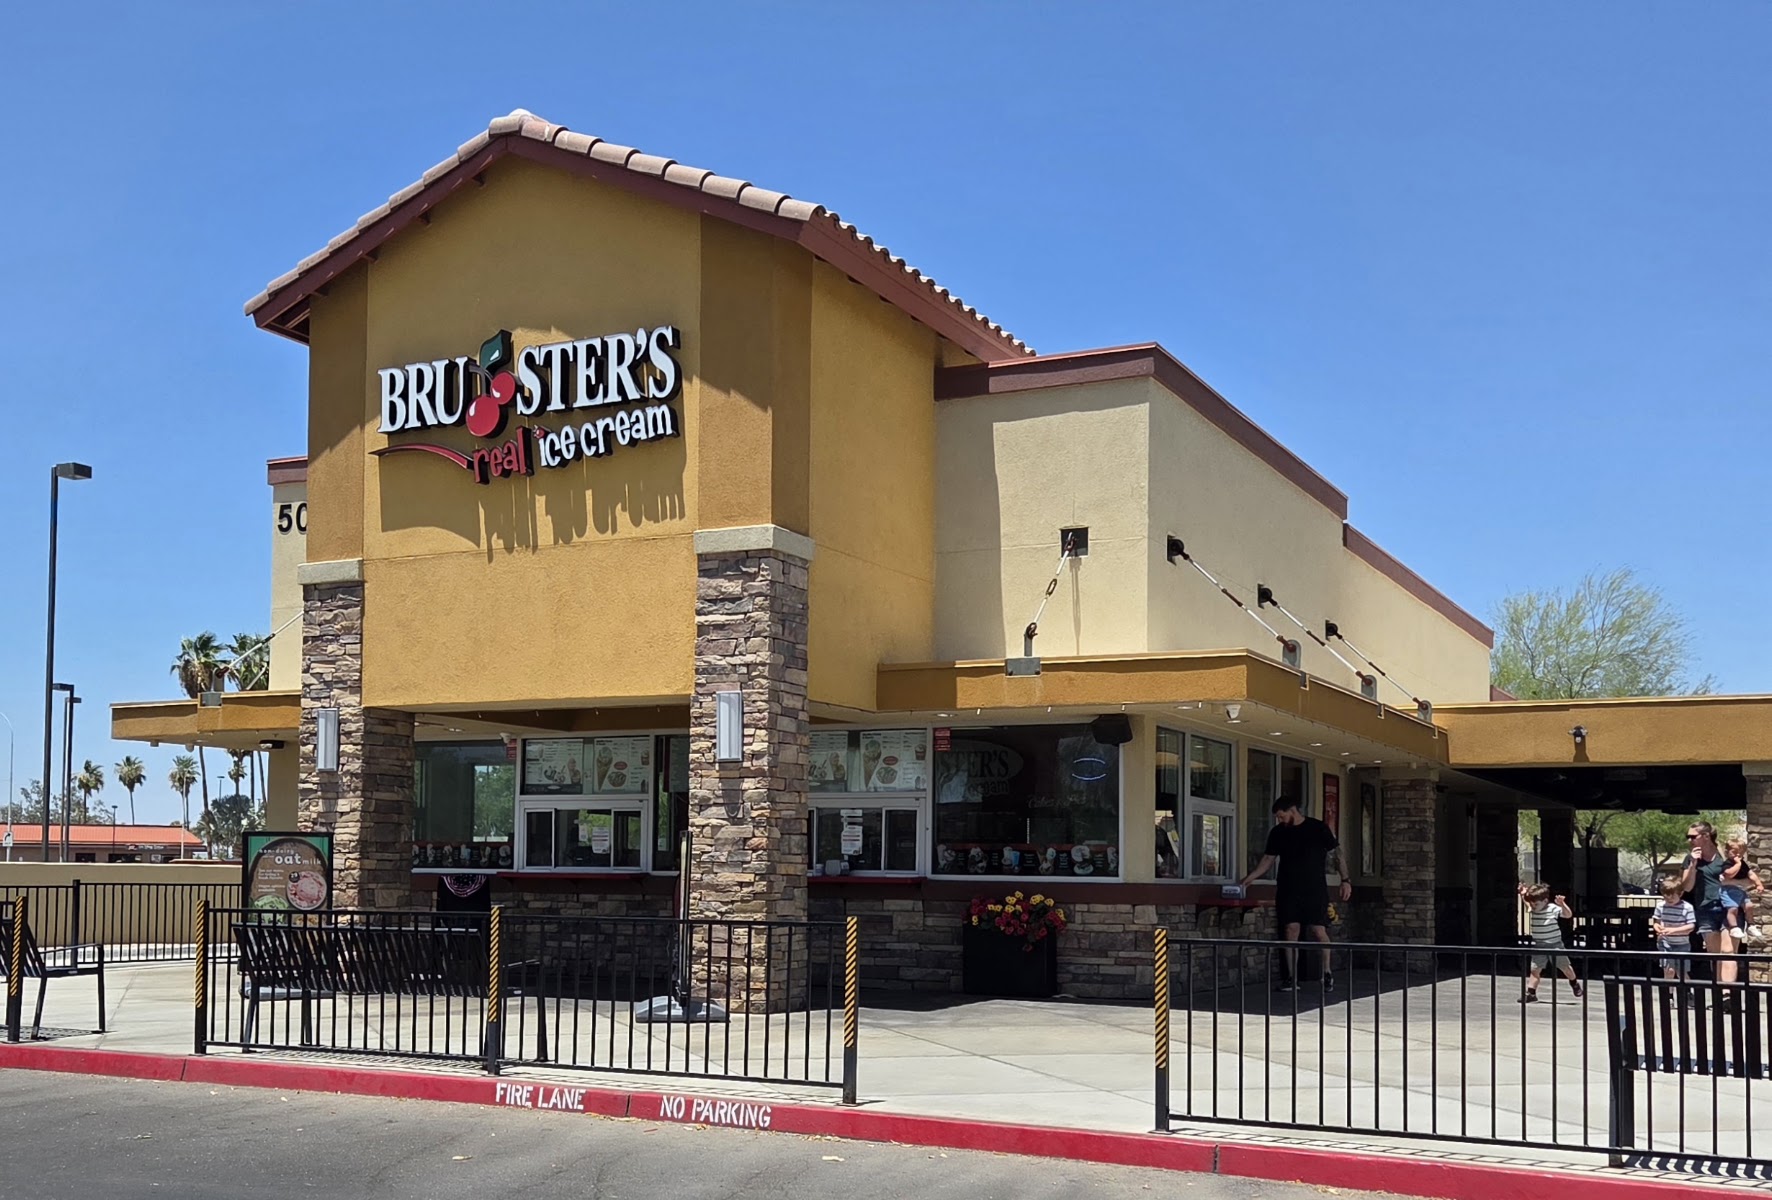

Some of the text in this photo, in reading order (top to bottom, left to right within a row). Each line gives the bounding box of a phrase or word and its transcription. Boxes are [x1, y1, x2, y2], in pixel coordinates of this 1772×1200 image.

[473, 424, 534, 485] real
[580, 403, 680, 458] cream
[275, 853, 302, 865] oat
[495, 1083, 587, 1110] FIRE LANE
[660, 1095, 772, 1128] NO PARKING
